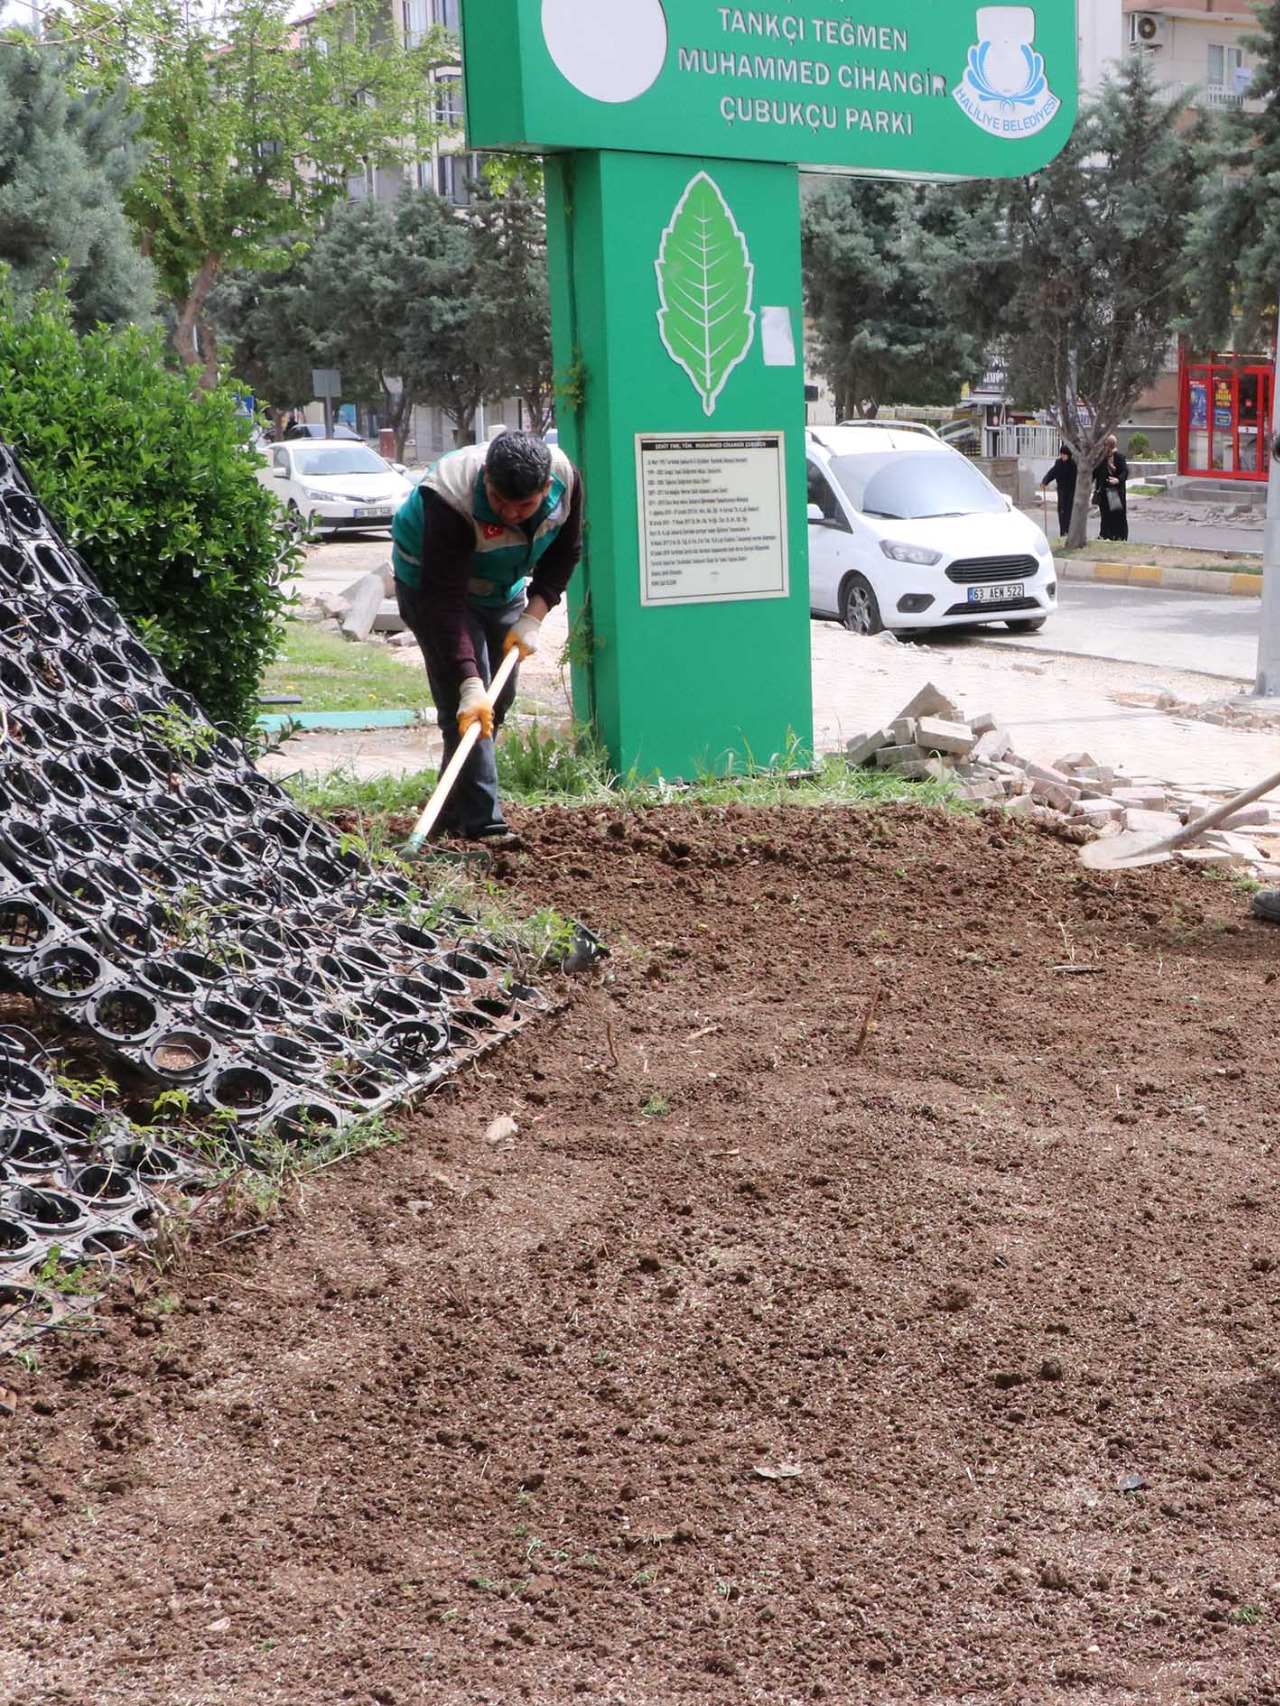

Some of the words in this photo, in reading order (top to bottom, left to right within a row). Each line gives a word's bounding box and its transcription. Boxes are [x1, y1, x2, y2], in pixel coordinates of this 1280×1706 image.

[717, 7, 805, 46] TANKÇI
[812, 15, 908, 52] TEĞMEN
[678, 47, 831, 86] MUHAMMED
[837, 60, 947, 98] CİHANGİR
[719, 96, 838, 134] ÇUBUKÇU
[844, 107, 914, 136] PARKI
[973, 588, 984, 600] 63
[1007, 584, 1022, 597] 522
